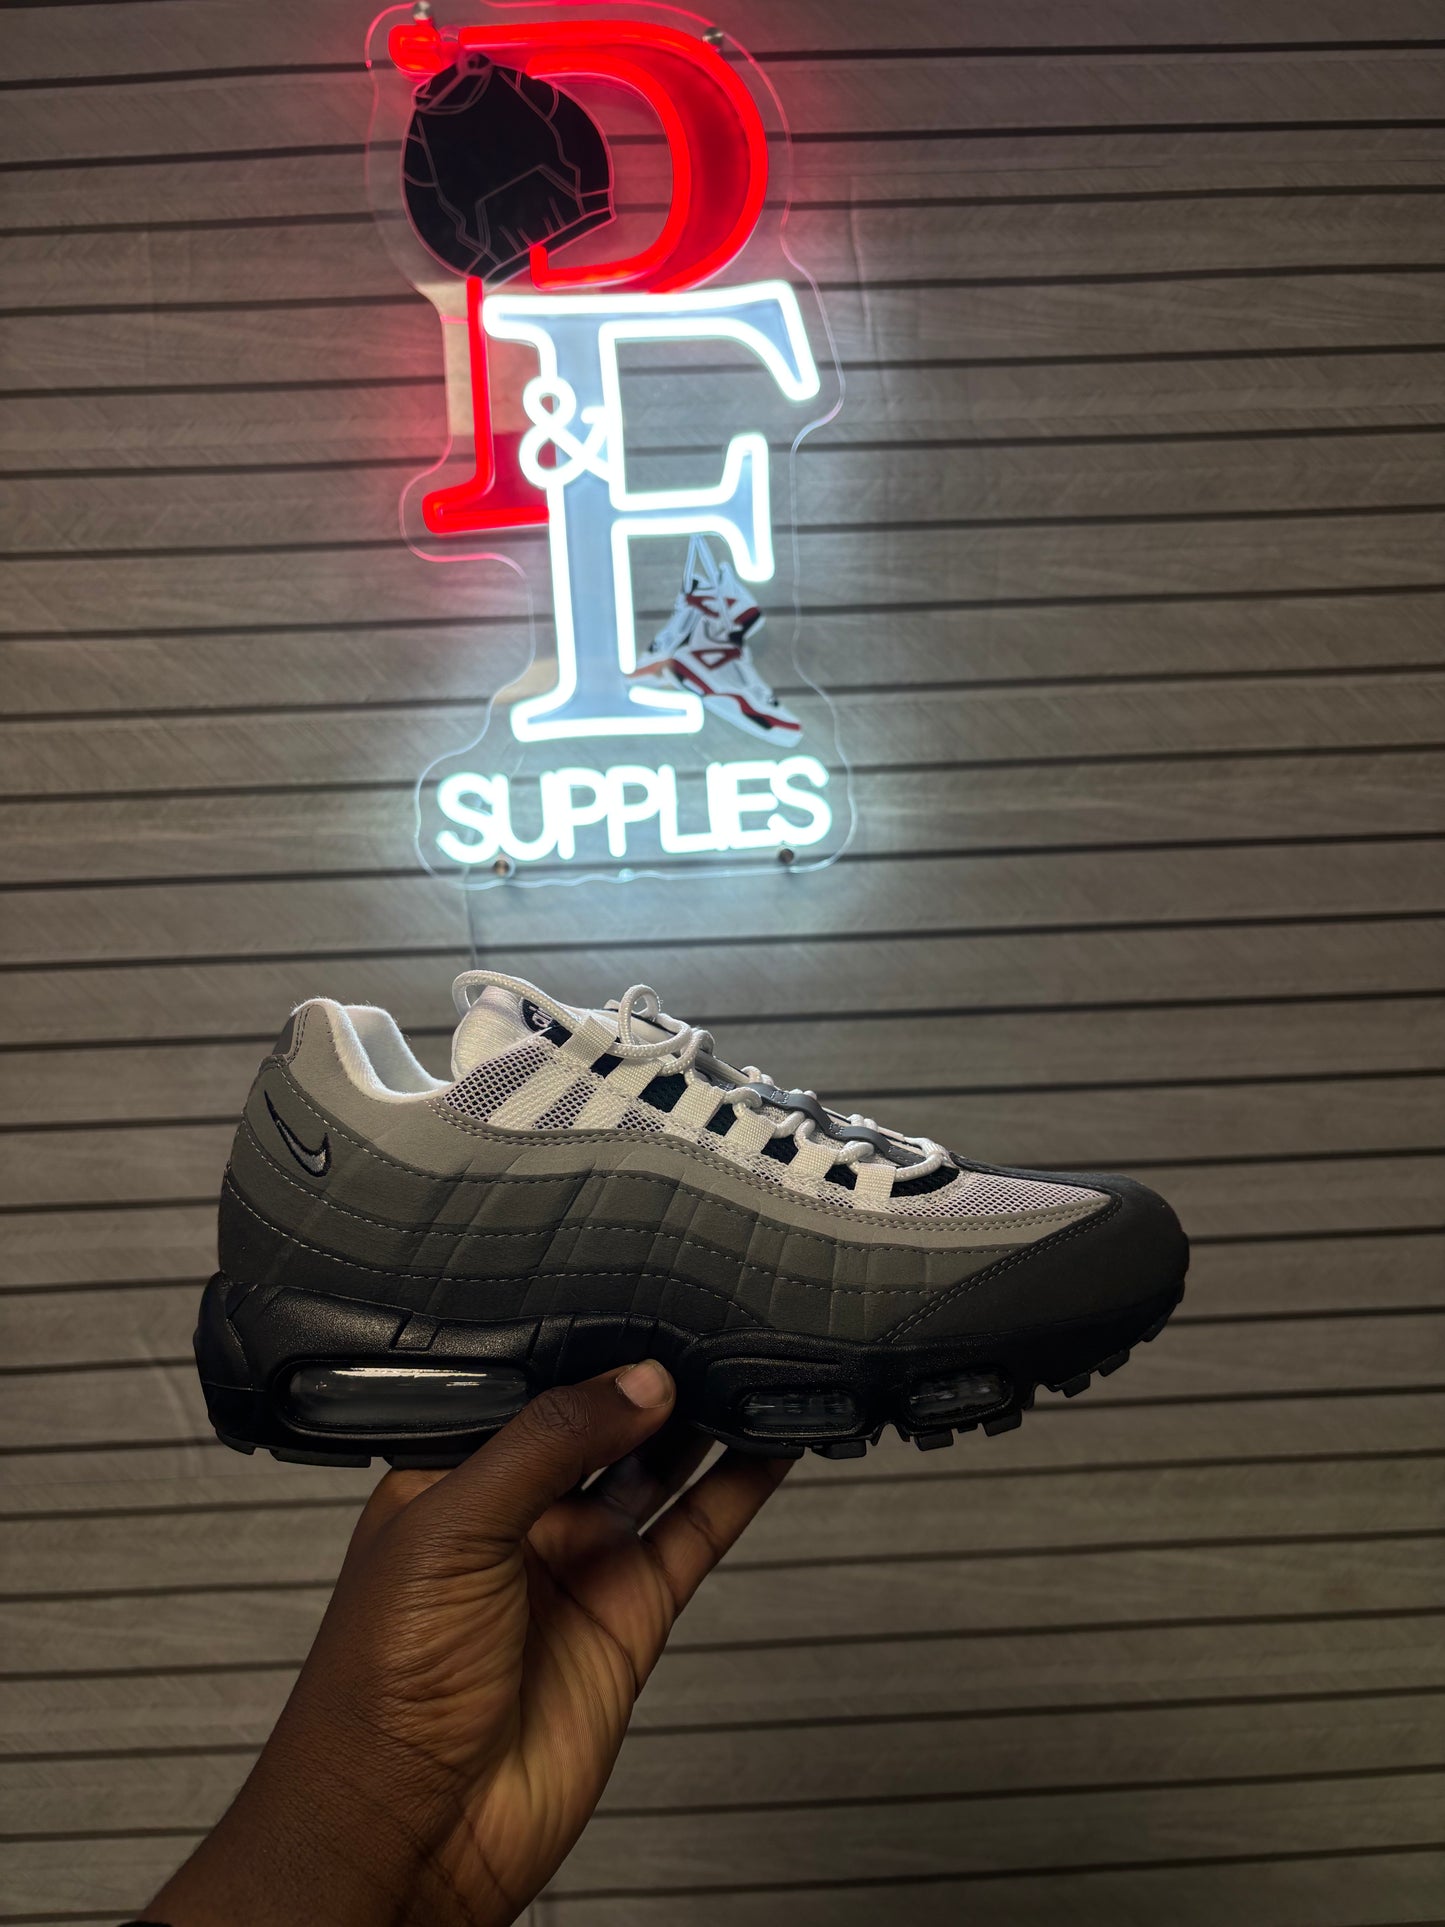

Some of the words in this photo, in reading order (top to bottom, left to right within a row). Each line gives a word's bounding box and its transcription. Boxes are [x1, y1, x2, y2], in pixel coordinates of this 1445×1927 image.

[518, 374, 614, 491] &
[483, 280, 820, 743] F
[436, 754, 833, 865] SUPPLIES
